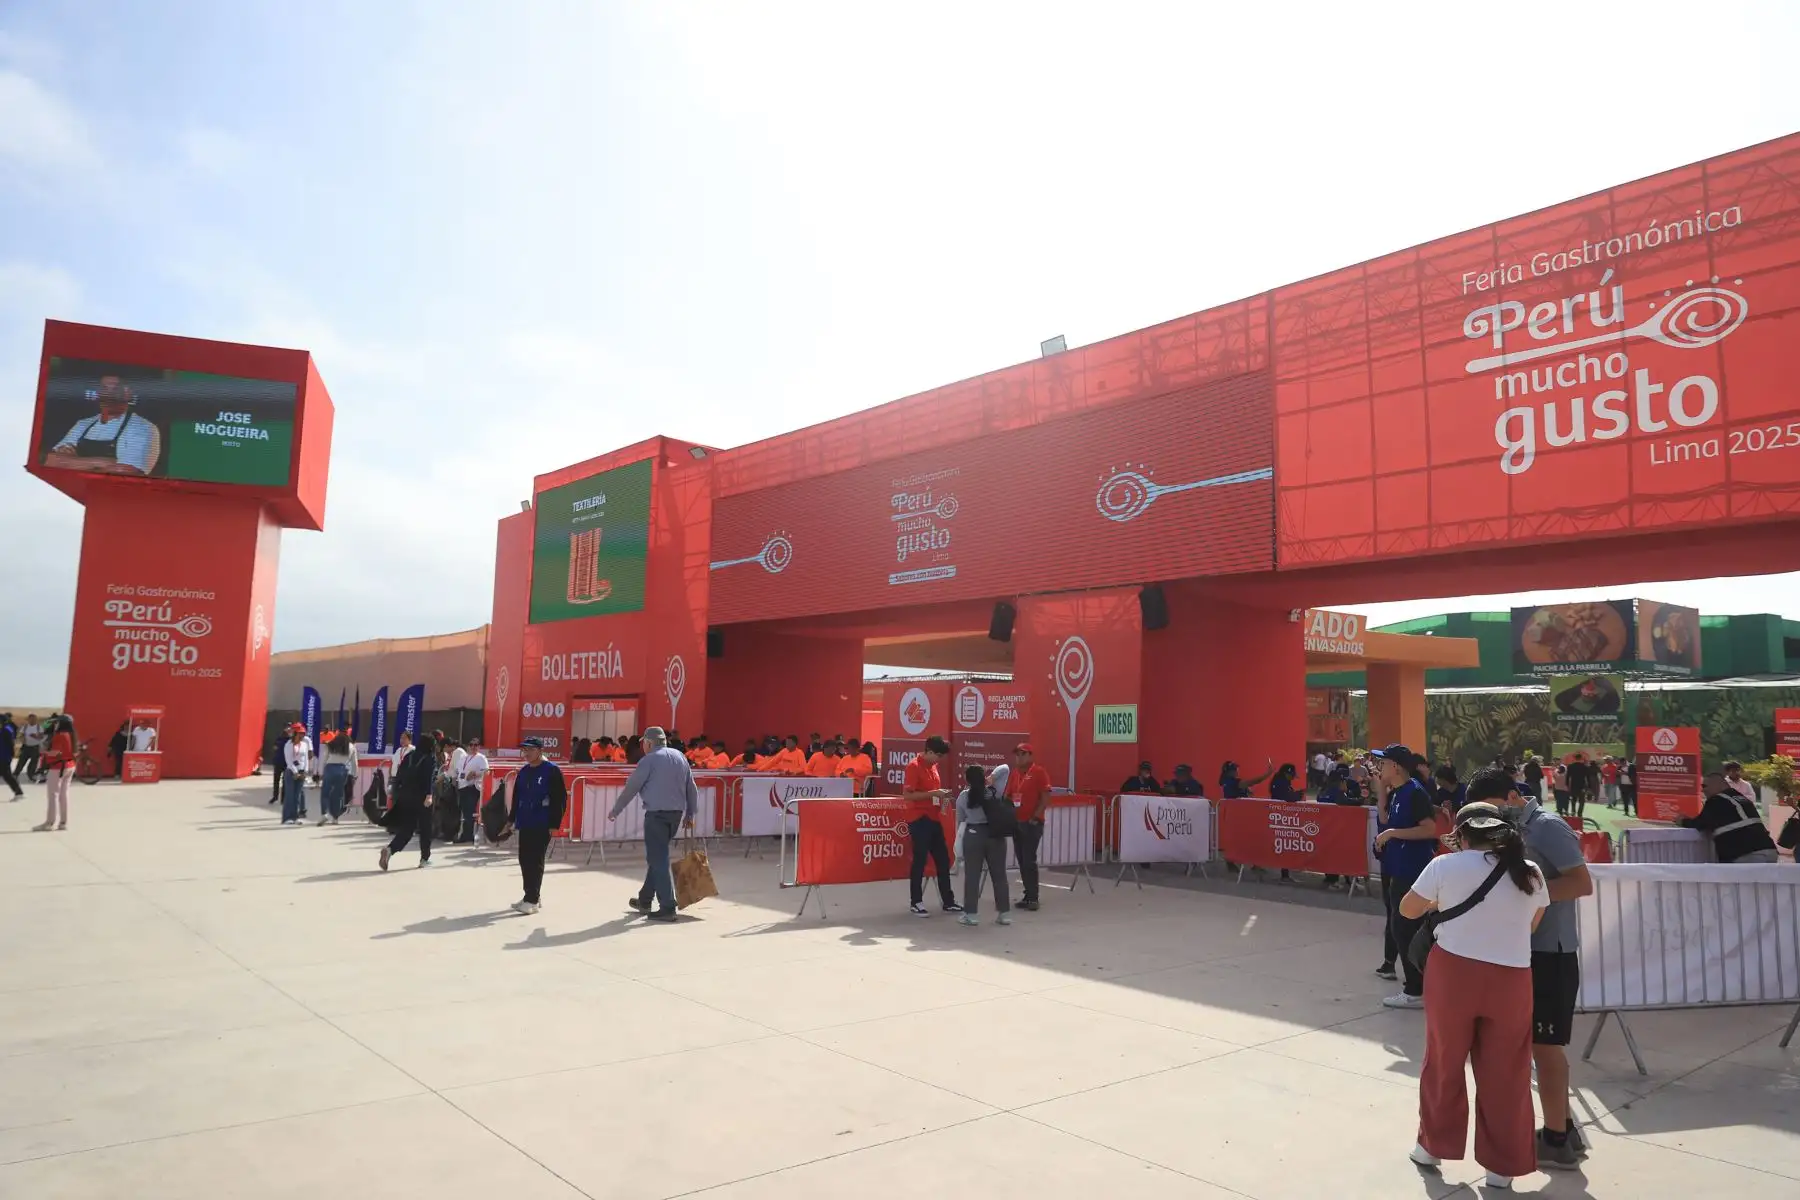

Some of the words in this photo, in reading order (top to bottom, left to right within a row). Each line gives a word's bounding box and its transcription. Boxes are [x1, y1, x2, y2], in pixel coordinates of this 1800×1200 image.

[1462, 262, 1523, 295] Feria
[1531, 205, 1743, 278] Gastronómica
[1462, 268, 1625, 350] Perú
[1494, 351, 1630, 400] mucho
[216, 411, 252, 424] JOSE
[1494, 367, 1720, 475] gusto
[194, 422, 270, 441] NOGUEIRA
[1650, 438, 1720, 466] Lima
[1728, 422, 1800, 455] 2025
[891, 486, 932, 512] Perú
[897, 517, 932, 533] mucho
[896, 525, 951, 562] gusto
[107, 584, 135, 595] Feria
[137, 585, 216, 600] Gastronómica
[105, 600, 172, 623] Perú
[115, 629, 170, 641] mucho
[112, 640, 199, 670] gusto
[541, 641, 624, 681] BOLETERÍA
[171, 667, 196, 677] Lima
[198, 668, 223, 678] 2025
[988, 695, 1026, 703] REGLAMENTO
[376, 695, 385, 751] ticketmaster
[992, 709, 1019, 720] FERIA
[1098, 712, 1133, 735] INGRESO
[1644, 765, 1688, 773] IMPORTANTE
[1648, 755, 1684, 766] AVISO
[783, 783, 824, 801] prom
[855, 811, 890, 827] Perú
[1156, 805, 1187, 826] prom
[1269, 813, 1300, 826] Perú
[863, 832, 892, 842] mucho
[1167, 819, 1192, 840] perú
[1274, 829, 1300, 838] mucho
[862, 840, 904, 865] gusto
[1274, 836, 1314, 854] gusto
